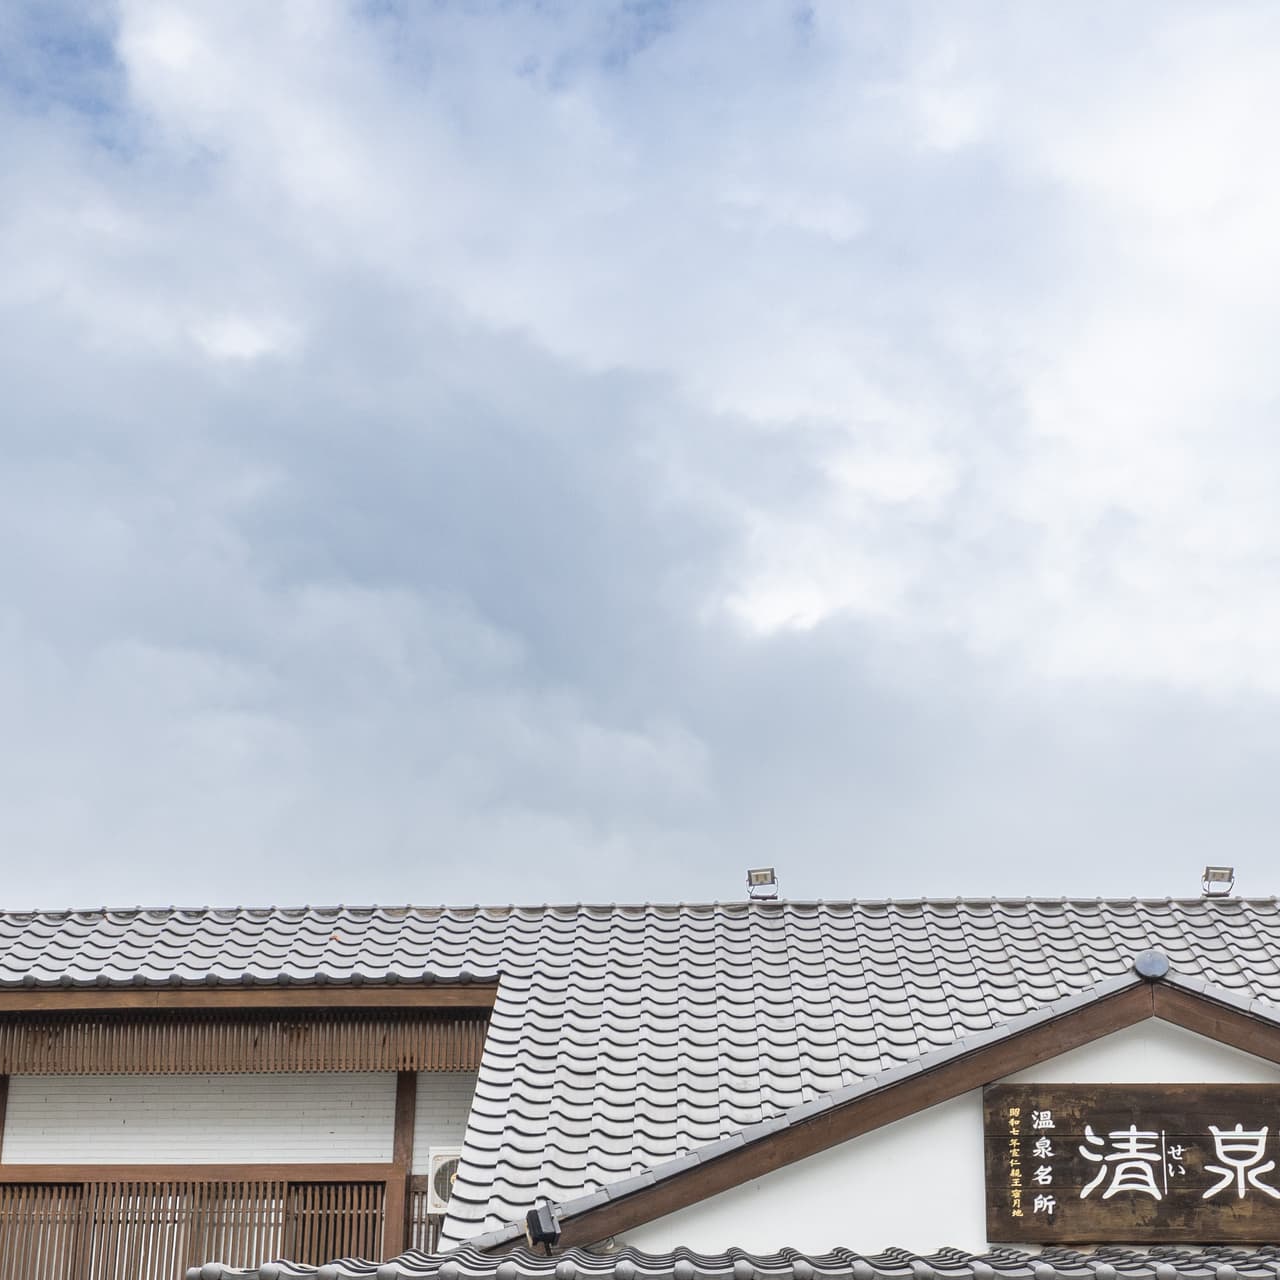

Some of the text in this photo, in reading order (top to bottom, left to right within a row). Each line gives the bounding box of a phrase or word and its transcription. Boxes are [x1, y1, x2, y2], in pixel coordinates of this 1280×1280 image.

[1031, 1110, 1056, 1214] 溫泉名所
[1167, 1145, 1186, 1177] せい
